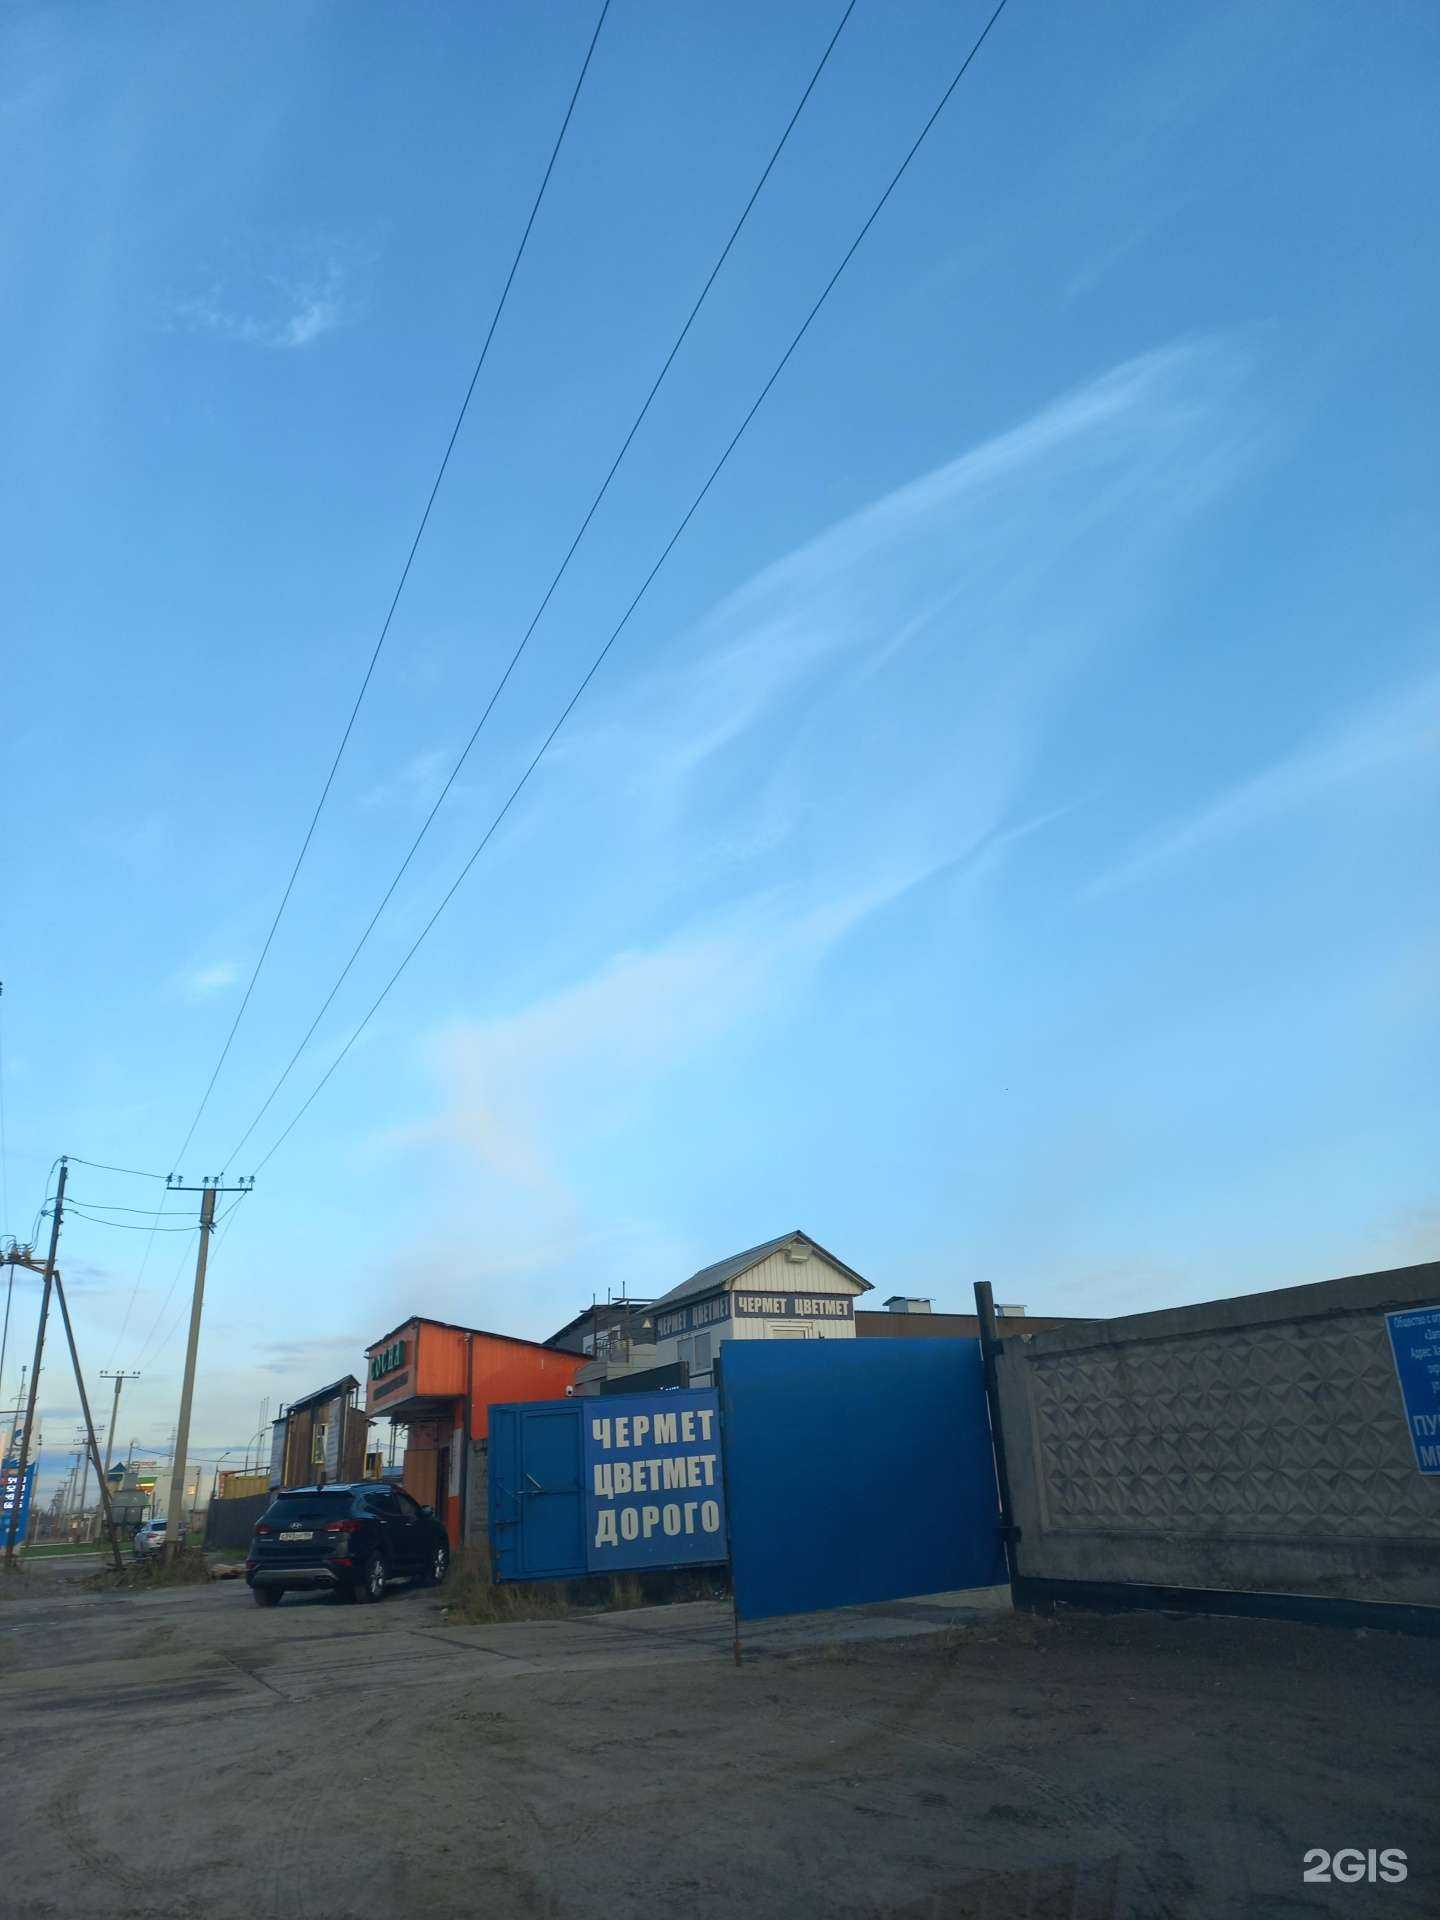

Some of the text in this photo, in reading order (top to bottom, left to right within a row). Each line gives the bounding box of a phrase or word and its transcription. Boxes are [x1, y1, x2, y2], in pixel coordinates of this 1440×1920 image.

[738, 1296, 849, 1316] ЧЕРМЕТ ЦВЕТМЕТ
[593, 1410, 713, 1449] ЧЕРМЕТ
[594, 1455, 716, 1500] ЦВЕТМЕТ
[595, 1500, 720, 1548] ДОРОГО
